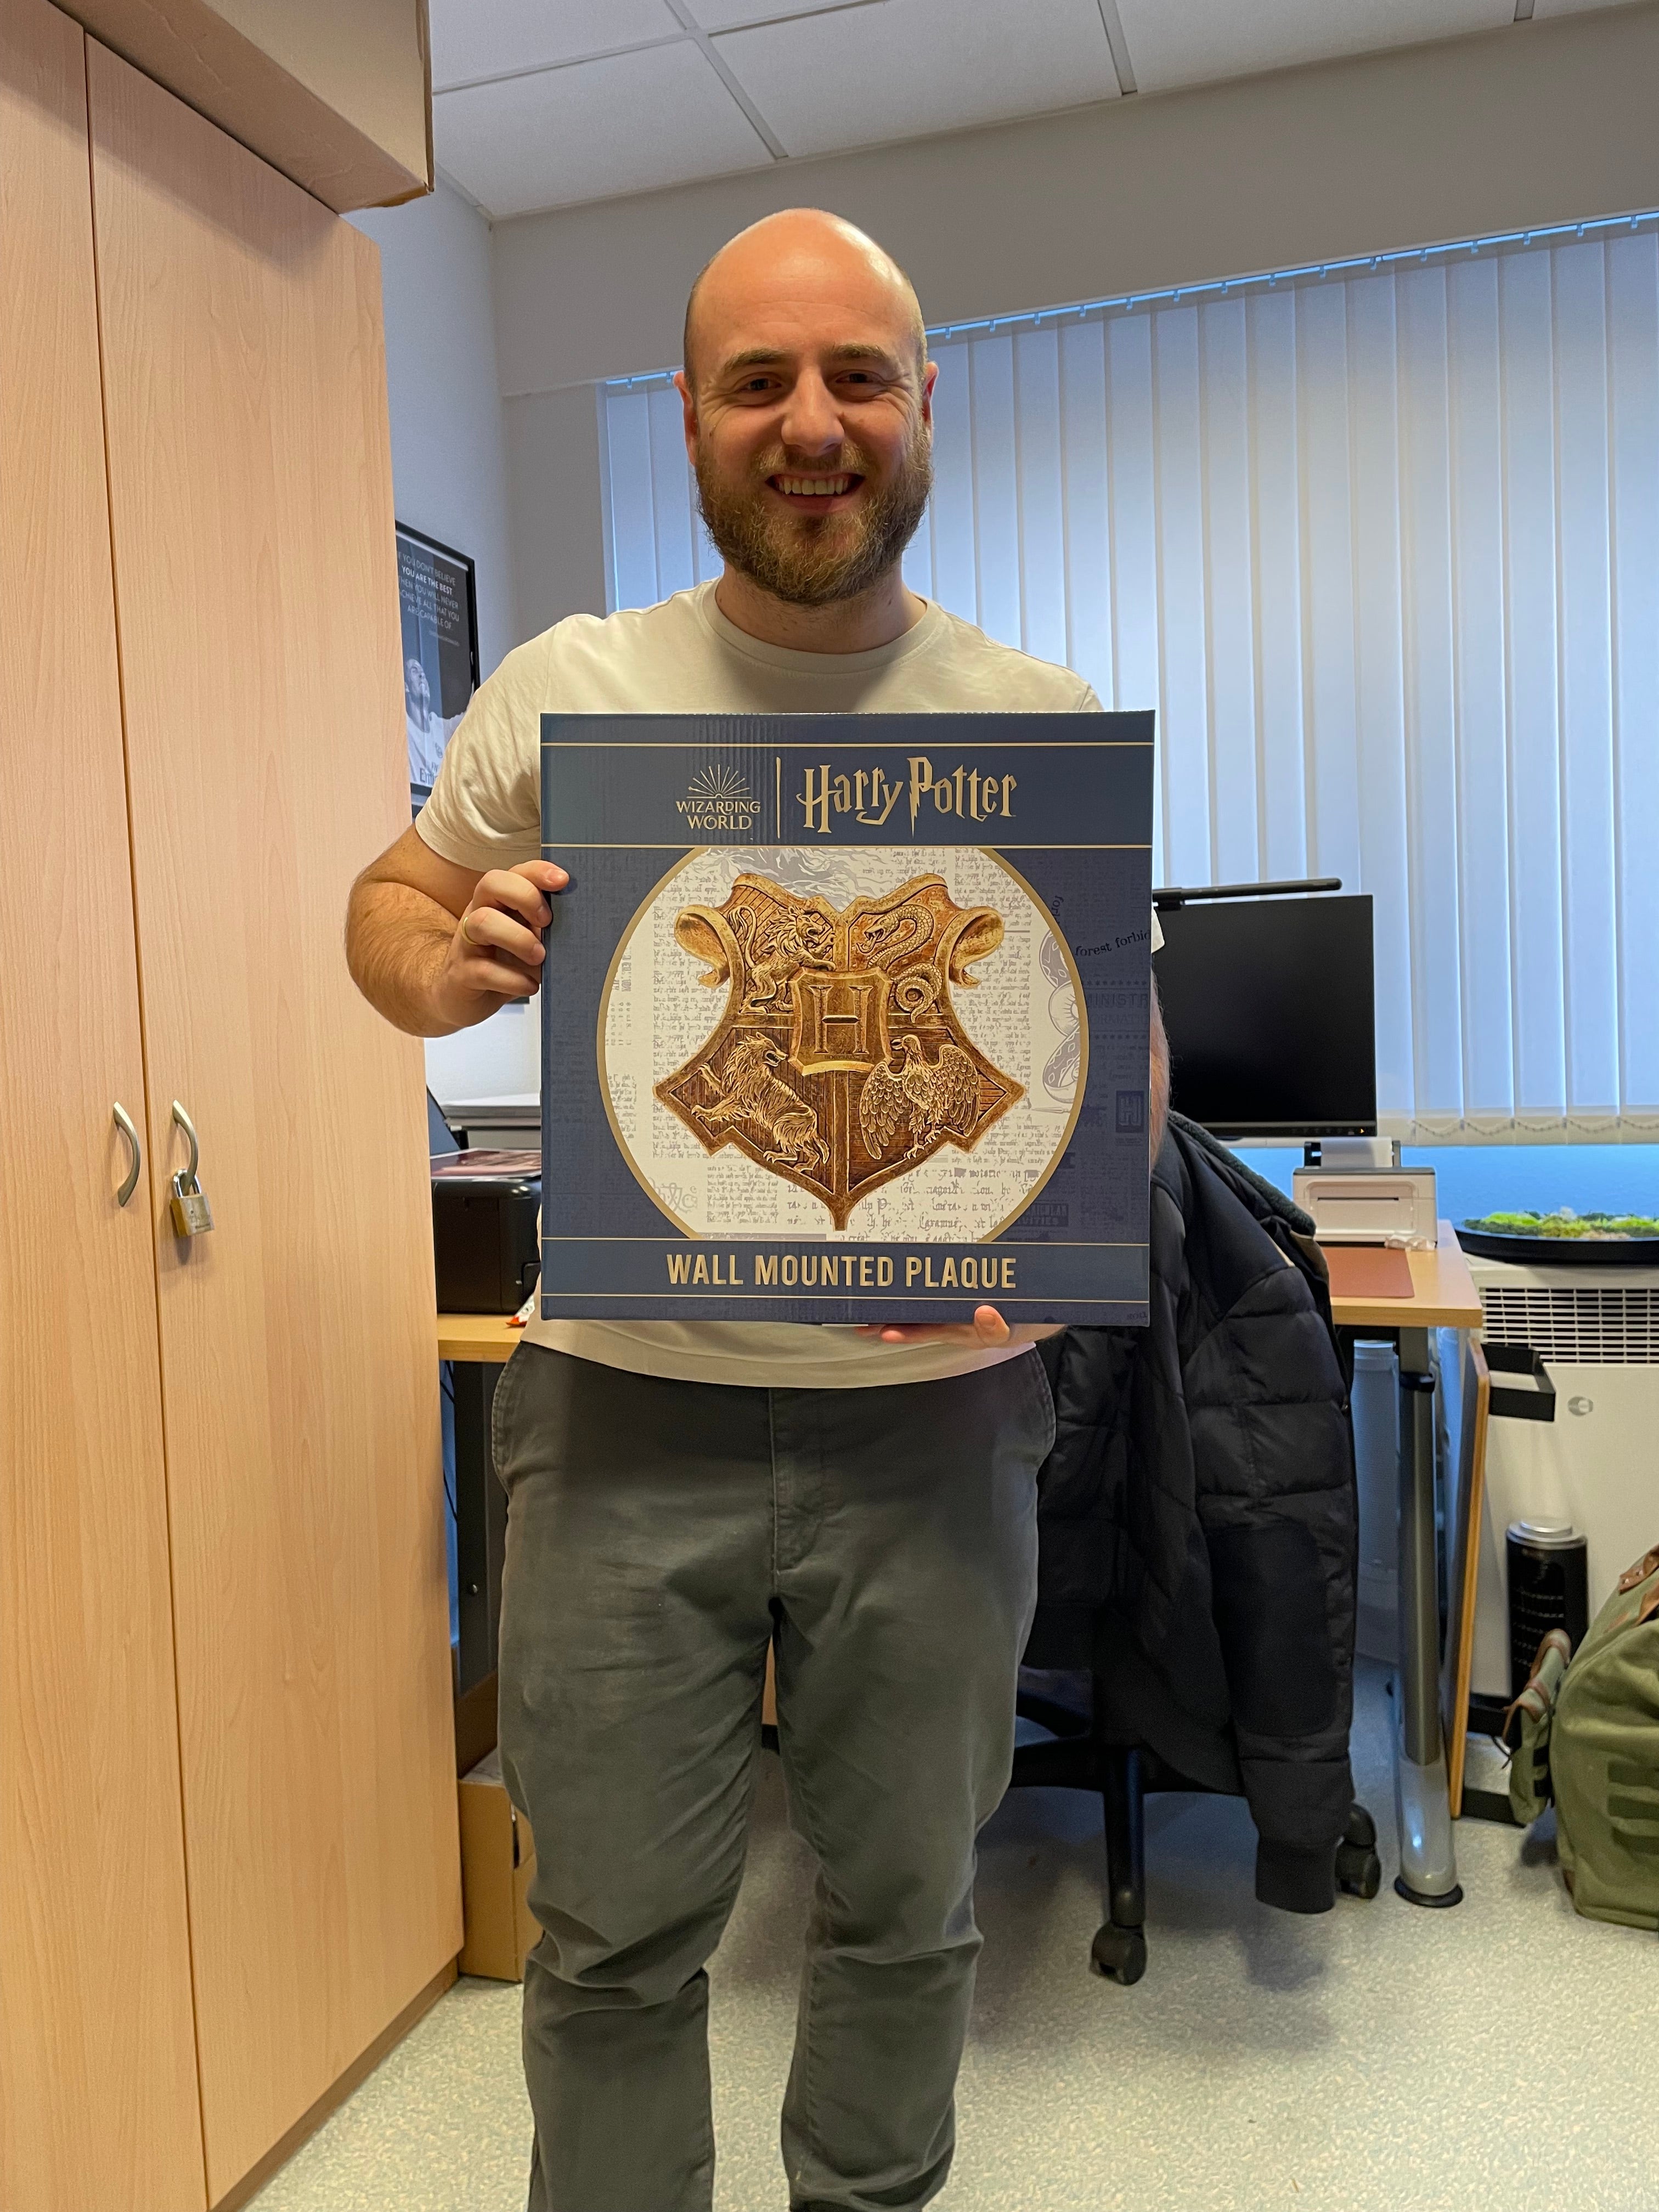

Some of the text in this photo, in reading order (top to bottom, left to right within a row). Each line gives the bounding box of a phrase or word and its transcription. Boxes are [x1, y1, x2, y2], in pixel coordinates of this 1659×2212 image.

[402, 565, 415, 577] YOU
[415, 573, 427, 583] ARE
[428, 577, 439, 589] THE
[403, 553, 415, 567] YOU
[435, 568, 455, 586] BELIEVE
[399, 589, 421, 605] CHIEVE
[448, 609, 460, 622] YOU
[441, 595, 459, 610] NEVER
[419, 610, 444, 627] CAPABLE
[675, 800, 761, 815] WIZARDING
[797, 757, 1017, 838] Harry Potter
[687, 815, 752, 830] WORLD
[1075, 942, 1112, 956] forest
[667, 1254, 1016, 1289] WALL MOUNTED PLAQUE
